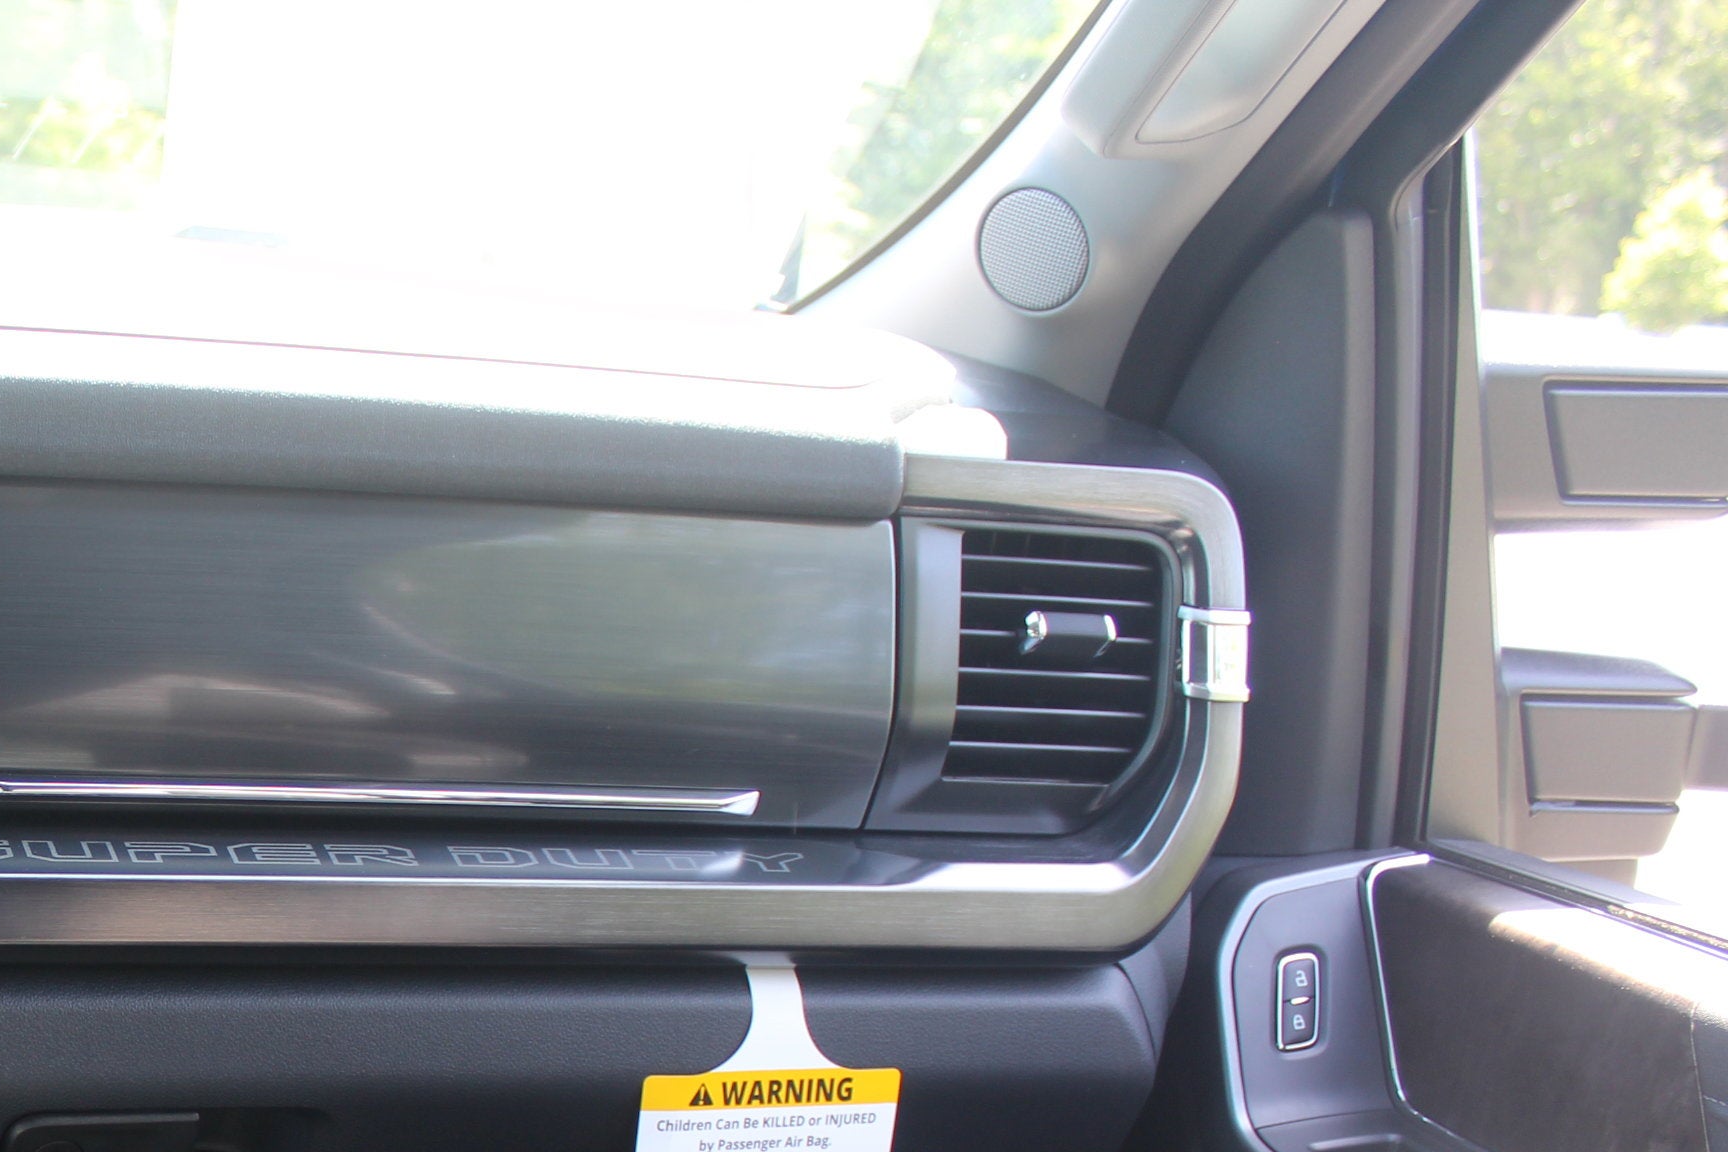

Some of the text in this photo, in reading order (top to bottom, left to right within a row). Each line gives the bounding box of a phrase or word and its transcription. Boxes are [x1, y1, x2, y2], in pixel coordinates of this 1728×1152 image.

[446, 845, 806, 873] DUTY
[721, 1077, 854, 1107] WARNING
[656, 1112, 877, 1132] Children Can Be KILLED or INJURED
[717, 1137, 782, 1152] Passenger
[784, 1136, 803, 1148] Air
[806, 1135, 832, 1150] Bag.
